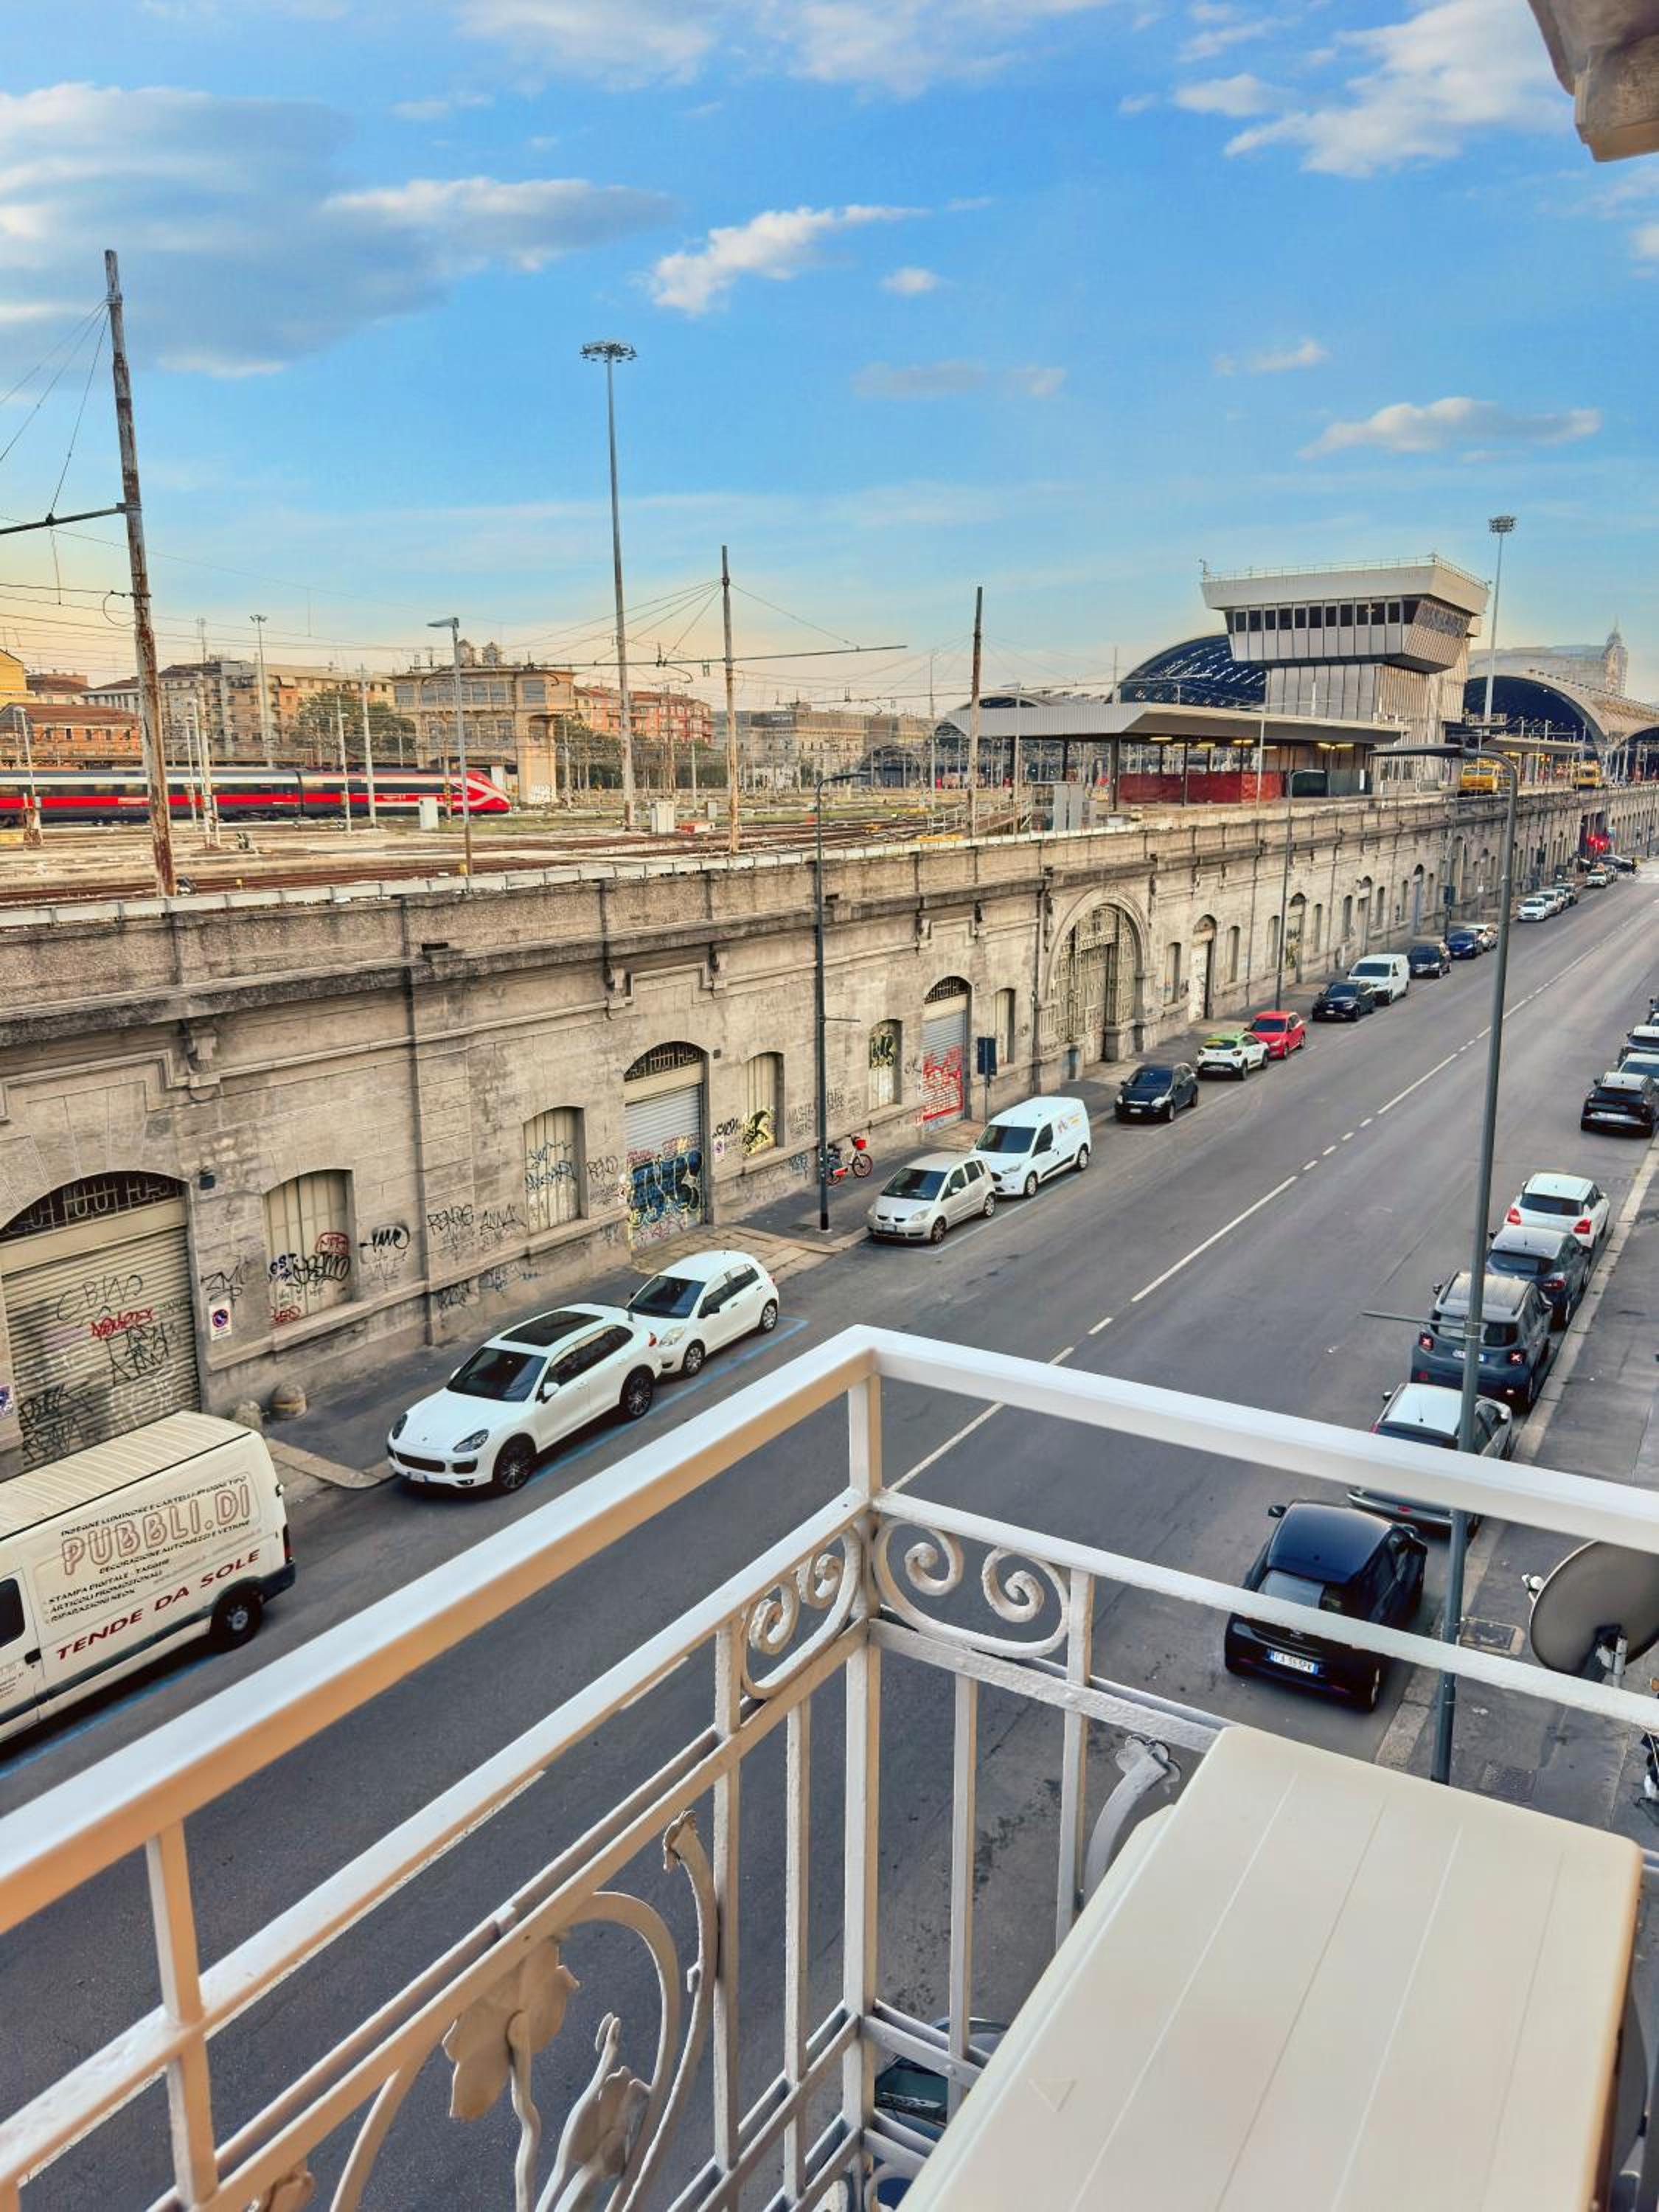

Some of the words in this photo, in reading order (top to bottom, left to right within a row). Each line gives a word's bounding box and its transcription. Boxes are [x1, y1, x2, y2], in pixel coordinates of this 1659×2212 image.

[61, 1484, 250, 1576] PUBBLI.DI
[48, 1586, 88, 1604] STAMPA
[89, 1572, 128, 1590] DIGITALE
[50, 1593, 94, 1613] ARTICOLI
[56, 1609, 143, 1661] TENDE
[154, 1586, 190, 1612] DA
[200, 1548, 261, 1588] SOLE
